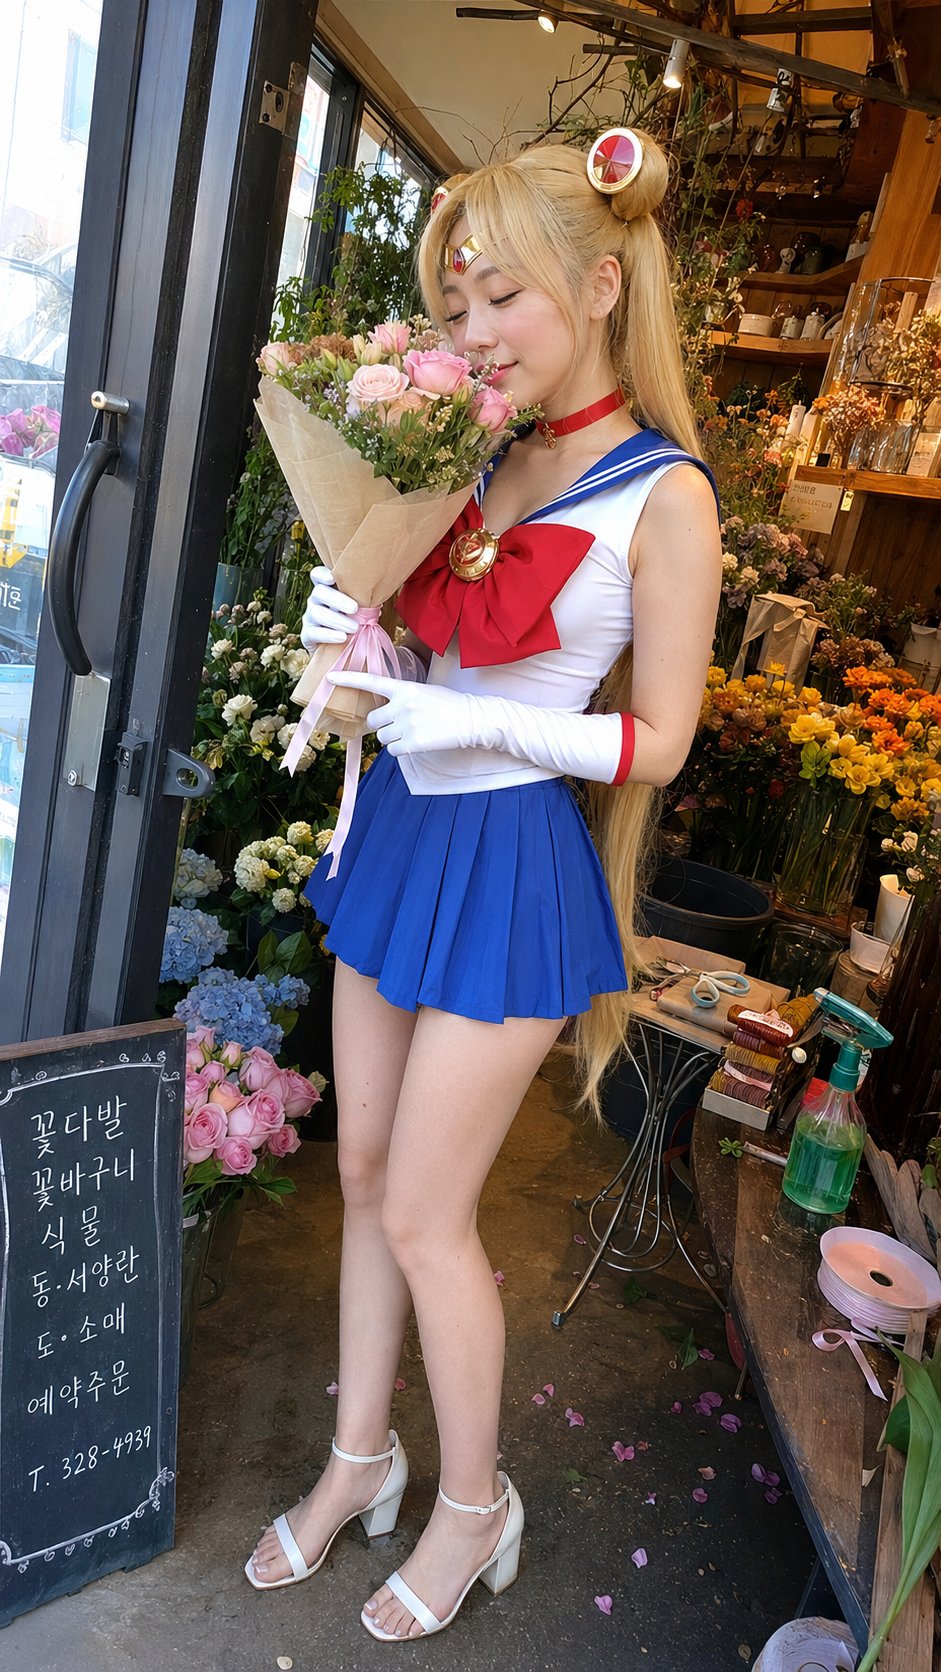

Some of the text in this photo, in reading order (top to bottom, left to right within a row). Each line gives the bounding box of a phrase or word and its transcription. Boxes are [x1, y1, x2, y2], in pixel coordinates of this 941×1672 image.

[30, 1094, 128, 1160] 꽃다발
[31, 1148, 136, 1213] 꽃바구니
[27, 1360, 130, 1416] 예약주문
[28, 1425, 152, 1493] T. 328-4939
